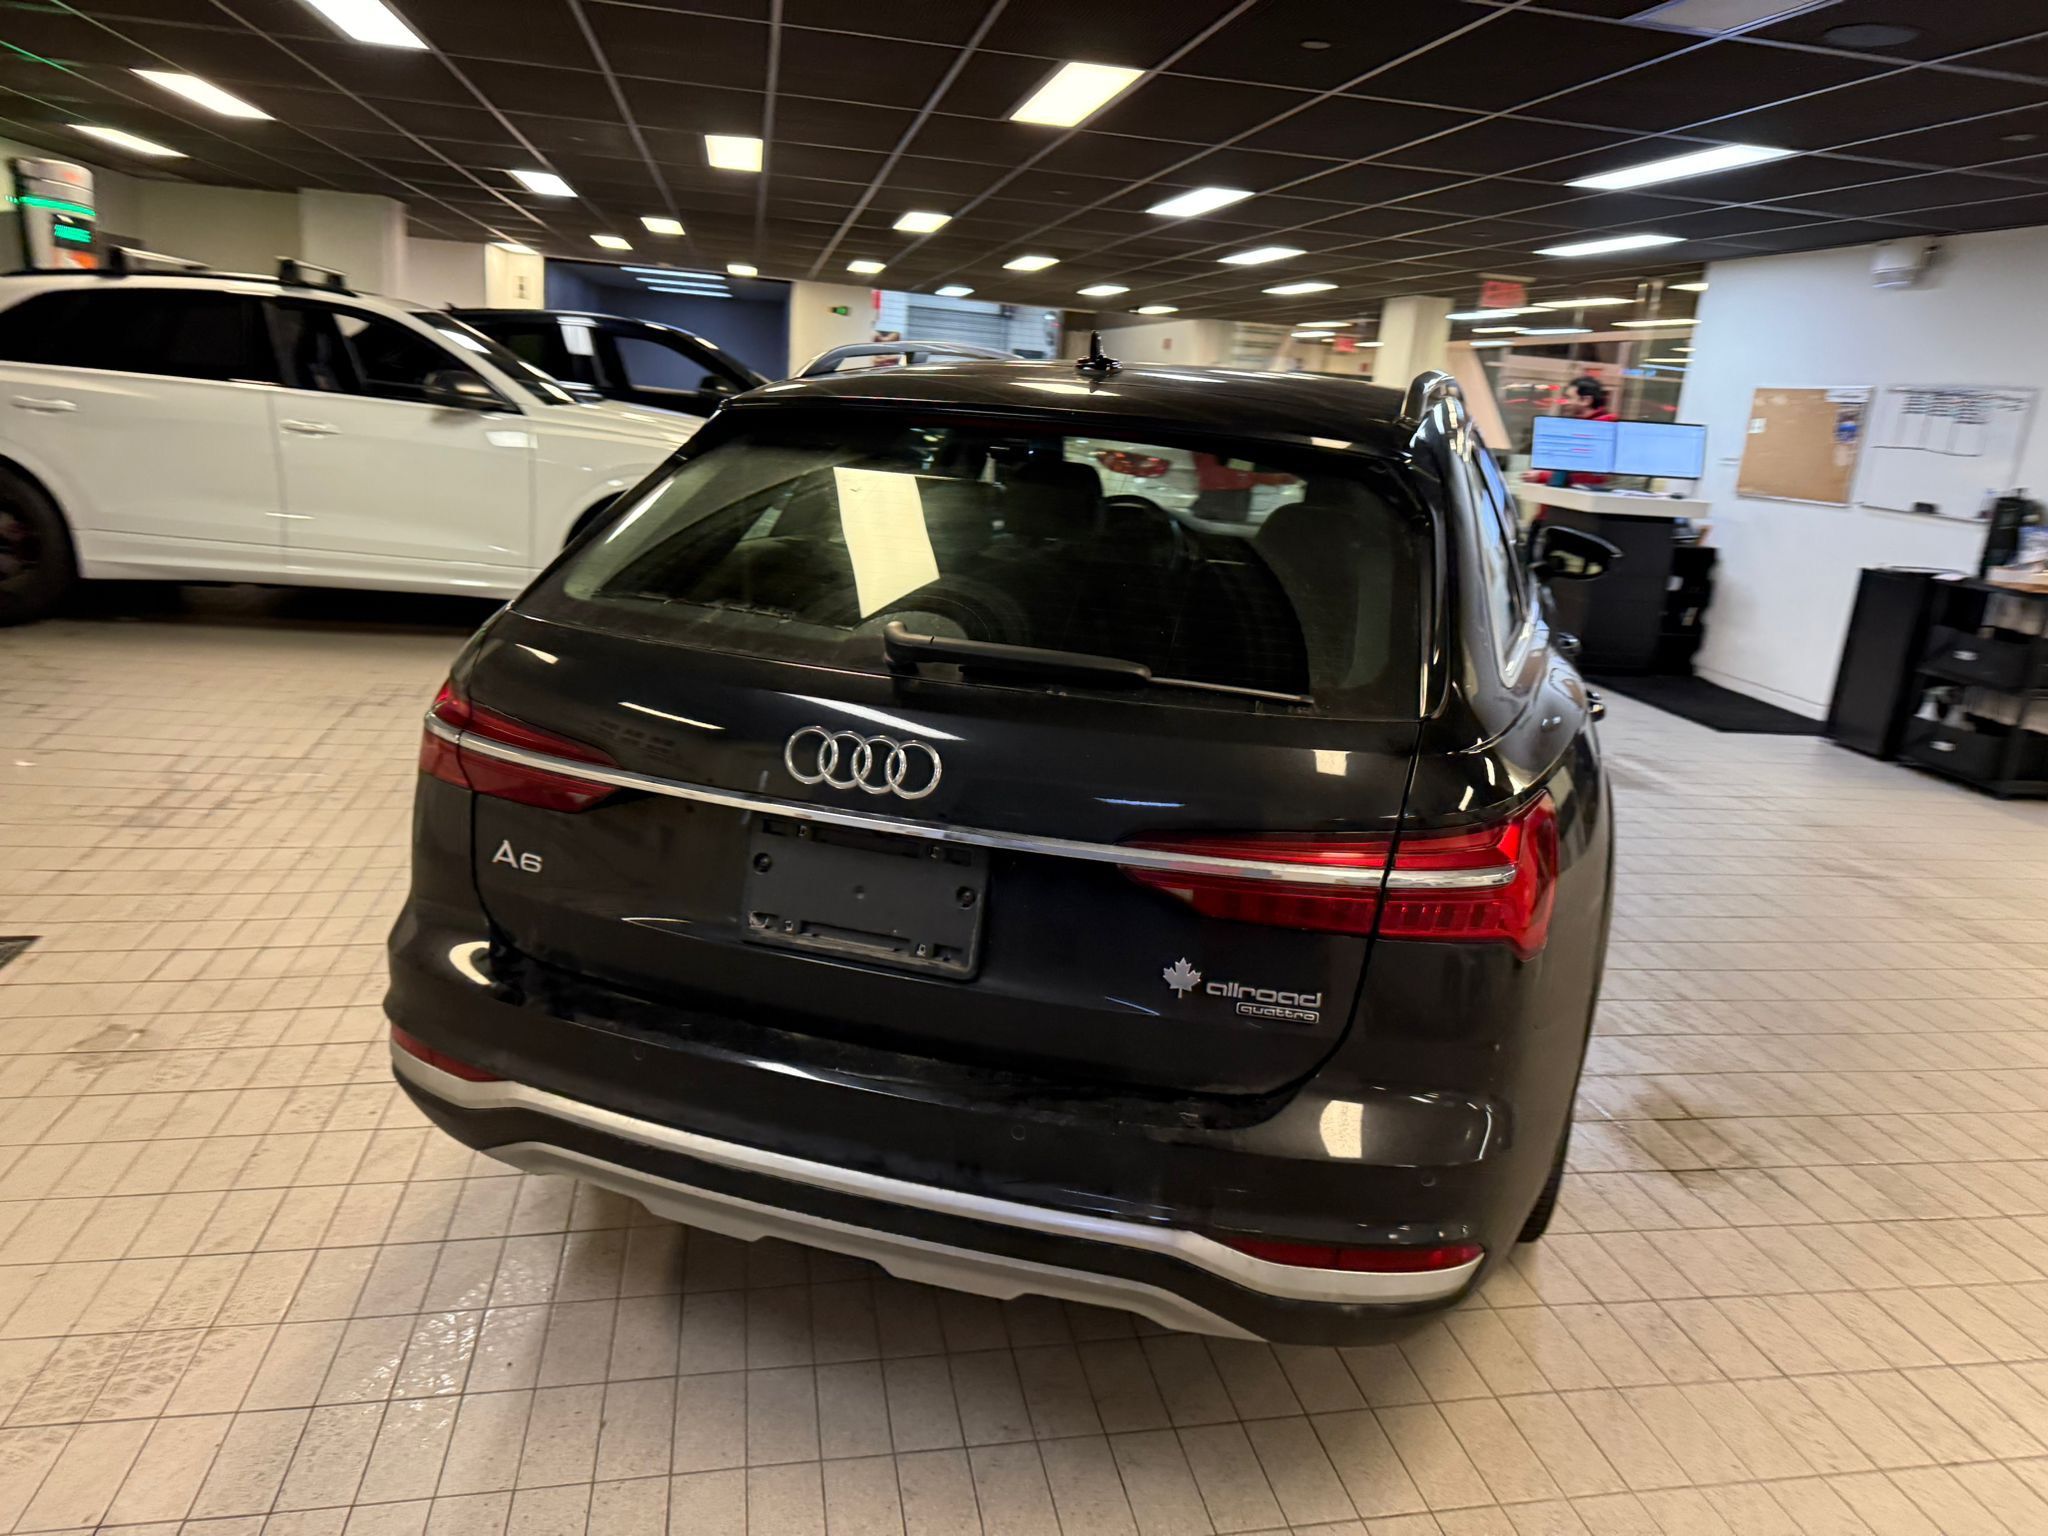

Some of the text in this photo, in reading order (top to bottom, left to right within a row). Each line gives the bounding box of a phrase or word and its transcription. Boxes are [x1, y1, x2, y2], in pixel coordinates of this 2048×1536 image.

[492, 839, 542, 873] A6
[1206, 982, 1322, 1008] allroad
[1239, 1005, 1316, 1022] quattro
